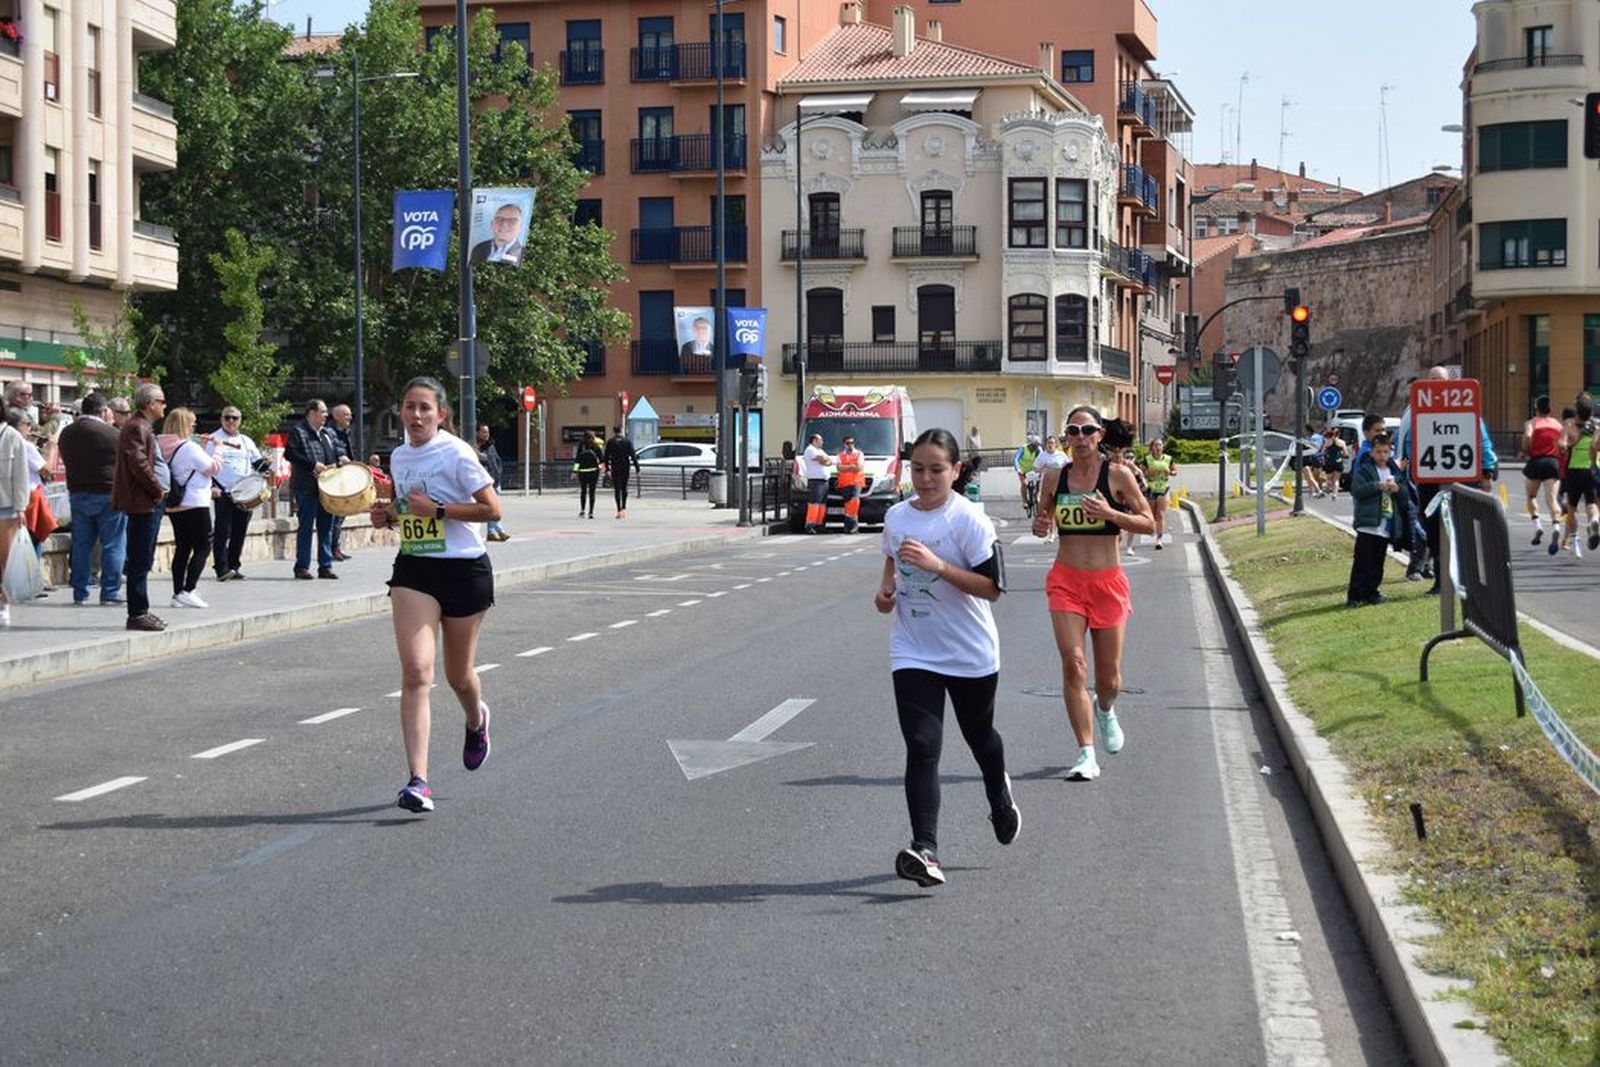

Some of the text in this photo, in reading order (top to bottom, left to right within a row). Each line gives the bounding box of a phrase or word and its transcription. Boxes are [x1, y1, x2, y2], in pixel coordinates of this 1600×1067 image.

[403, 211, 439, 223] VOTA
[735, 319, 759, 327] VOTA
[1417, 388, 1474, 408] N-122
[1432, 421, 1460, 435] km
[1419, 443, 1474, 470] 459
[403, 518, 439, 539] 664
